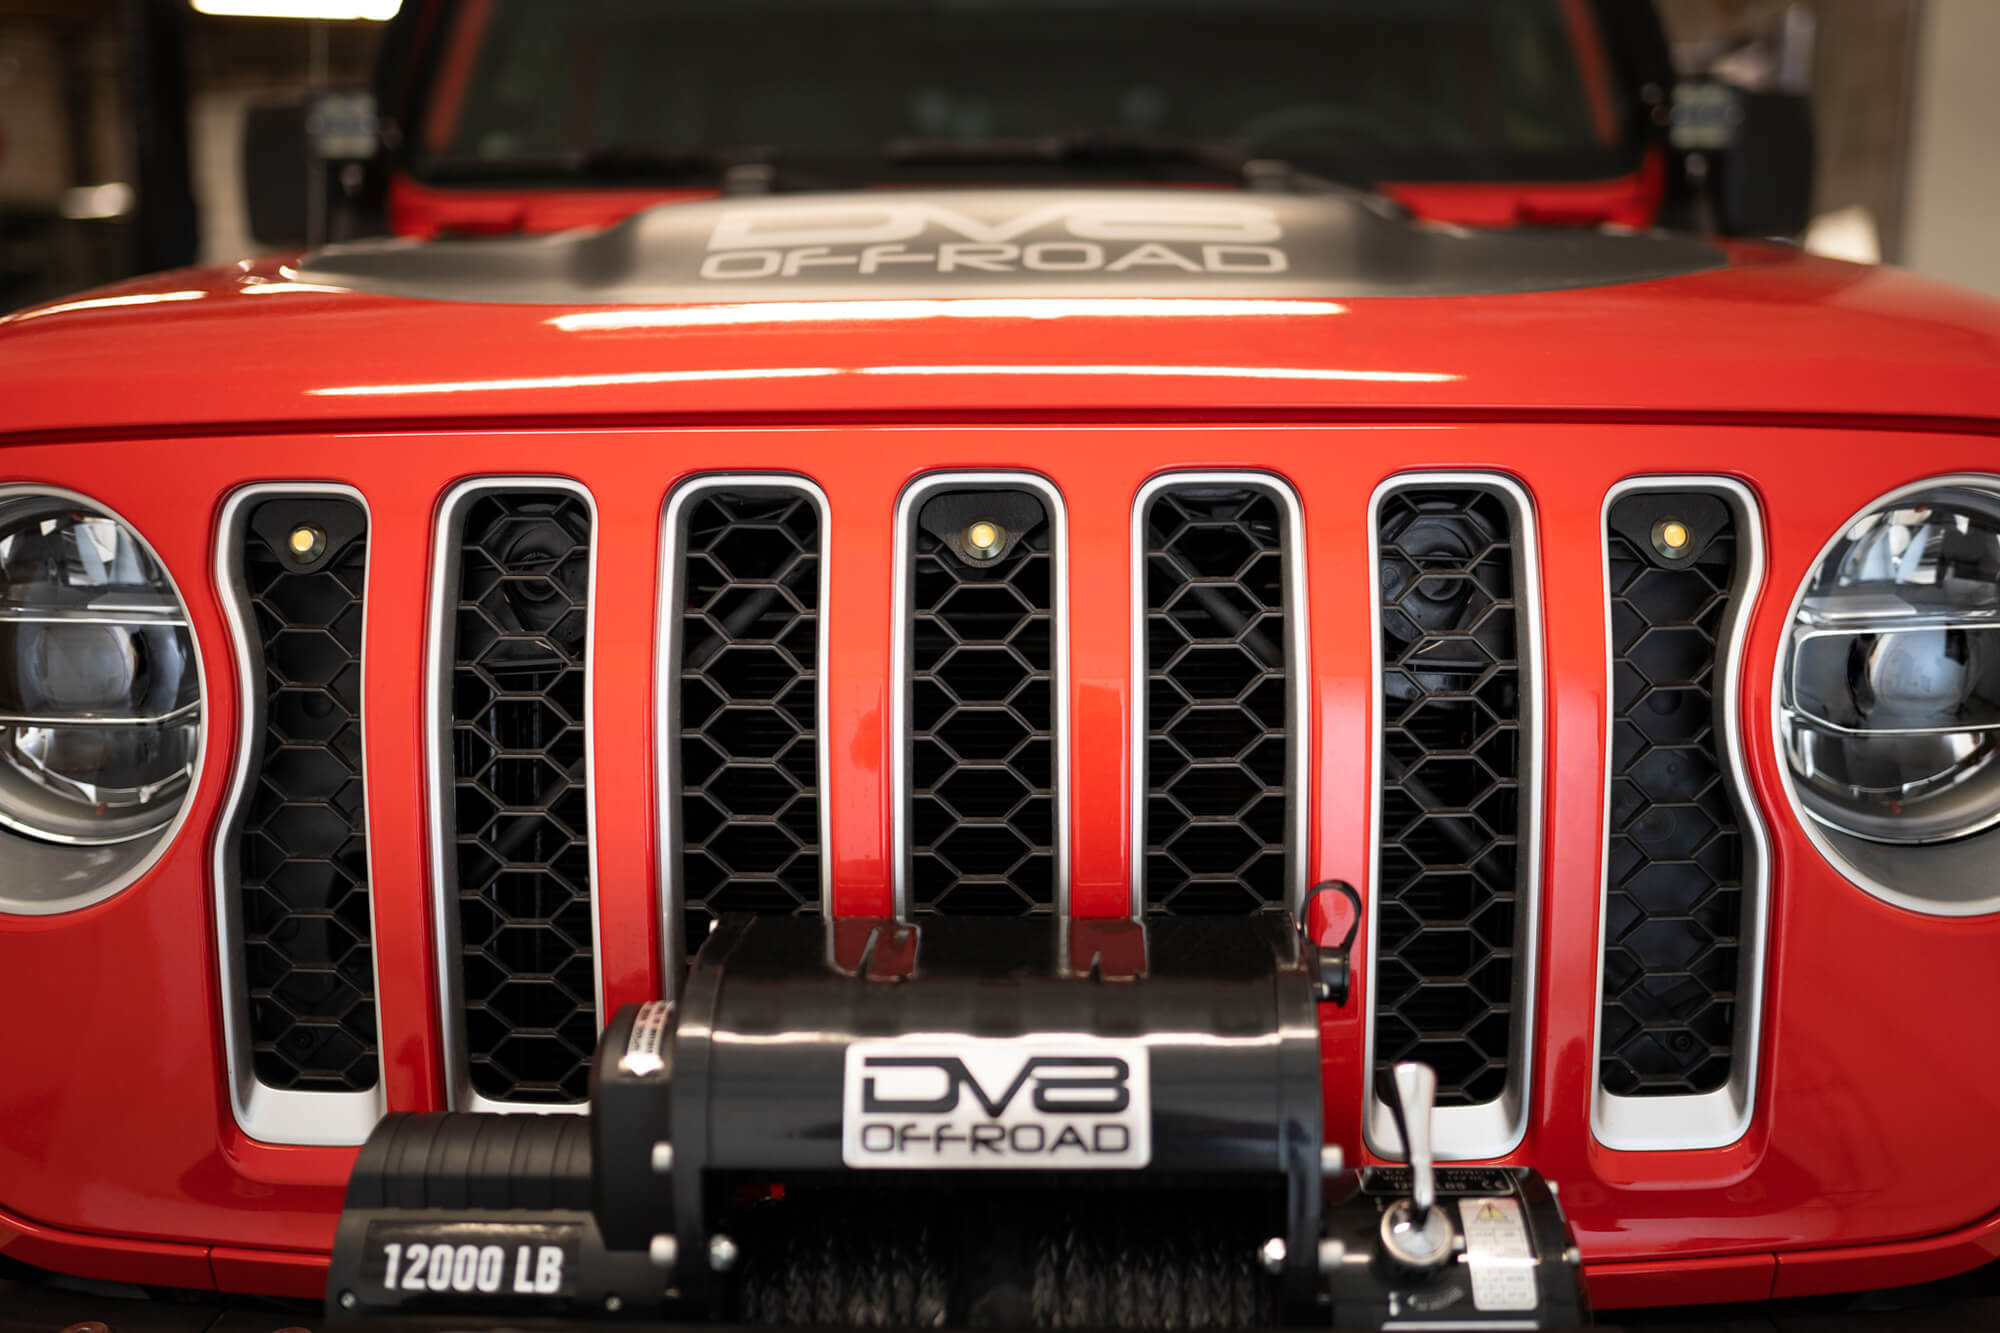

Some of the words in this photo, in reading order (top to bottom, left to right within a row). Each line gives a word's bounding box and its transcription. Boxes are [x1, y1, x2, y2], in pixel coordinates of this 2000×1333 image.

[705, 202, 1283, 246] DV8
[701, 243, 1288, 279] OFFROAD
[861, 1056, 1130, 1118] DV8
[861, 1123, 1130, 1155] OFFROAD
[384, 1243, 504, 1292] 12000
[513, 1245, 564, 1293] LB
